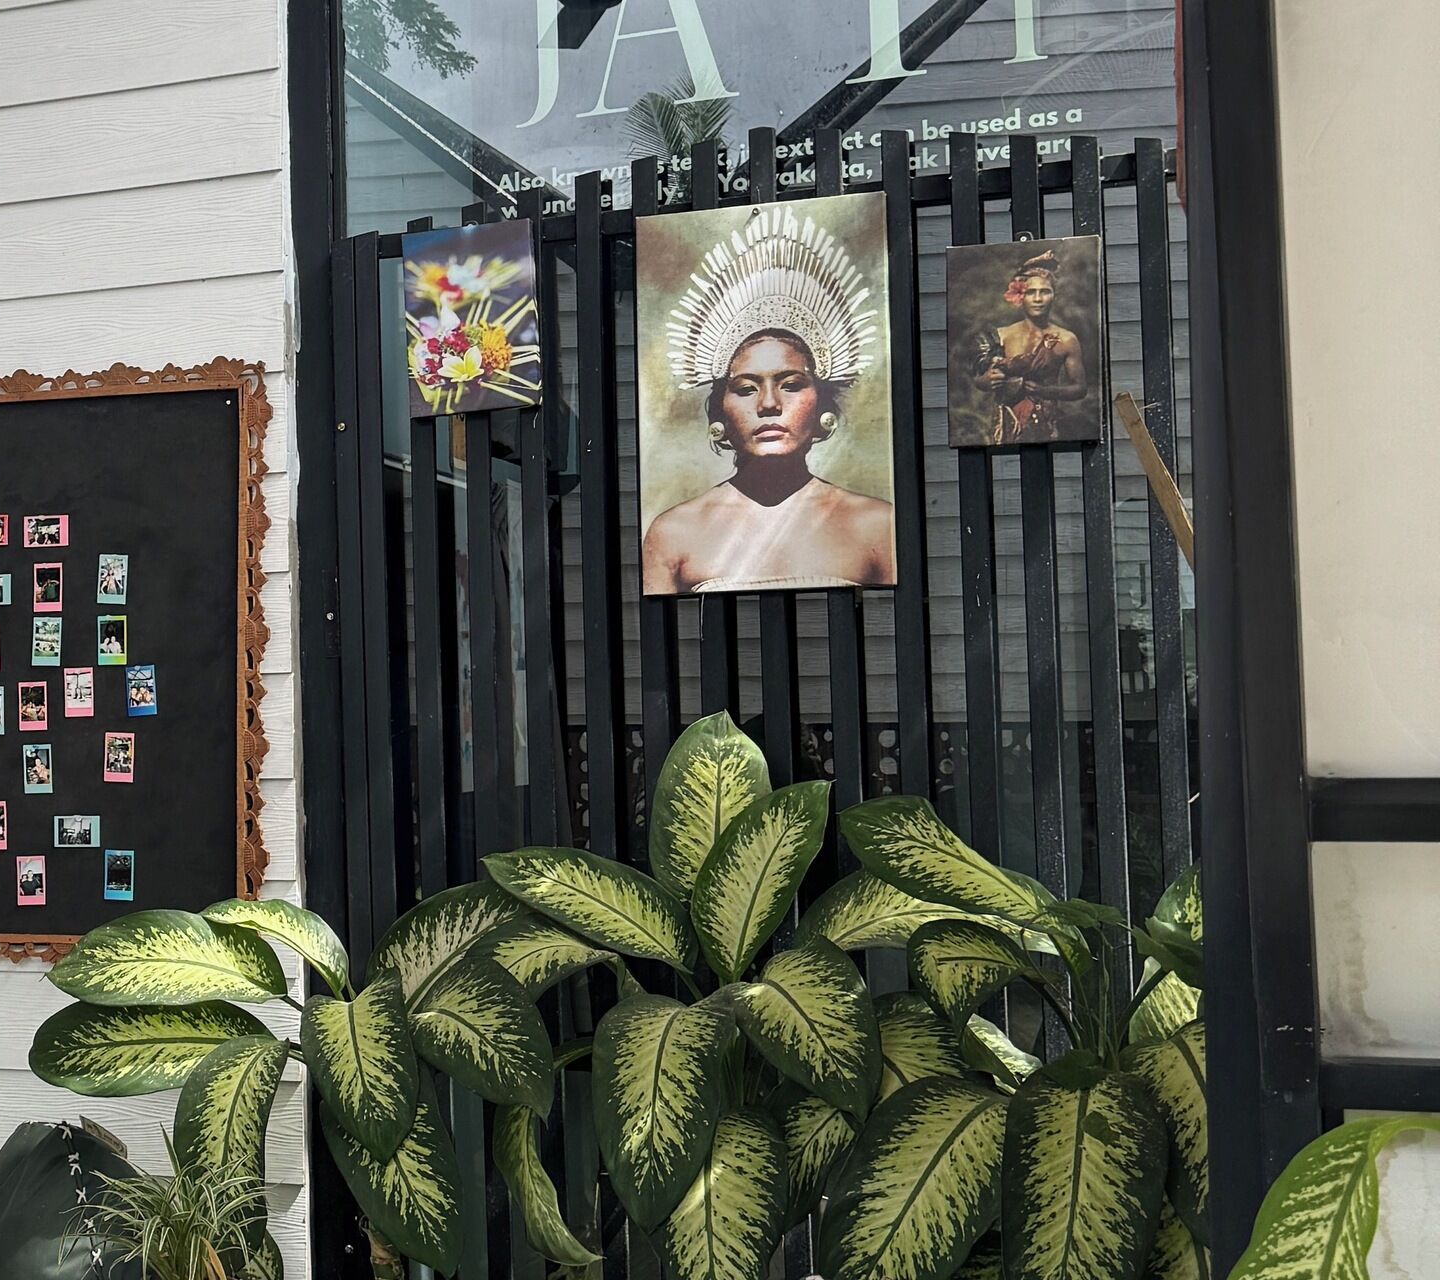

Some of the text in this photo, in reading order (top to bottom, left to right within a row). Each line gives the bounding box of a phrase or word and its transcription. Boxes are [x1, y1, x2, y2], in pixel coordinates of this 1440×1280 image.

[496, 171, 545, 194] Also
[552, 165, 631, 187] knwn
[670, 152, 731, 173] tek,
[775, 130, 864, 159] extct
[870, 128, 915, 148] cn
[922, 119, 954, 141] be
[961, 107, 1021, 134] used
[1028, 110, 1059, 128] as
[1065, 107, 1083, 123] a
